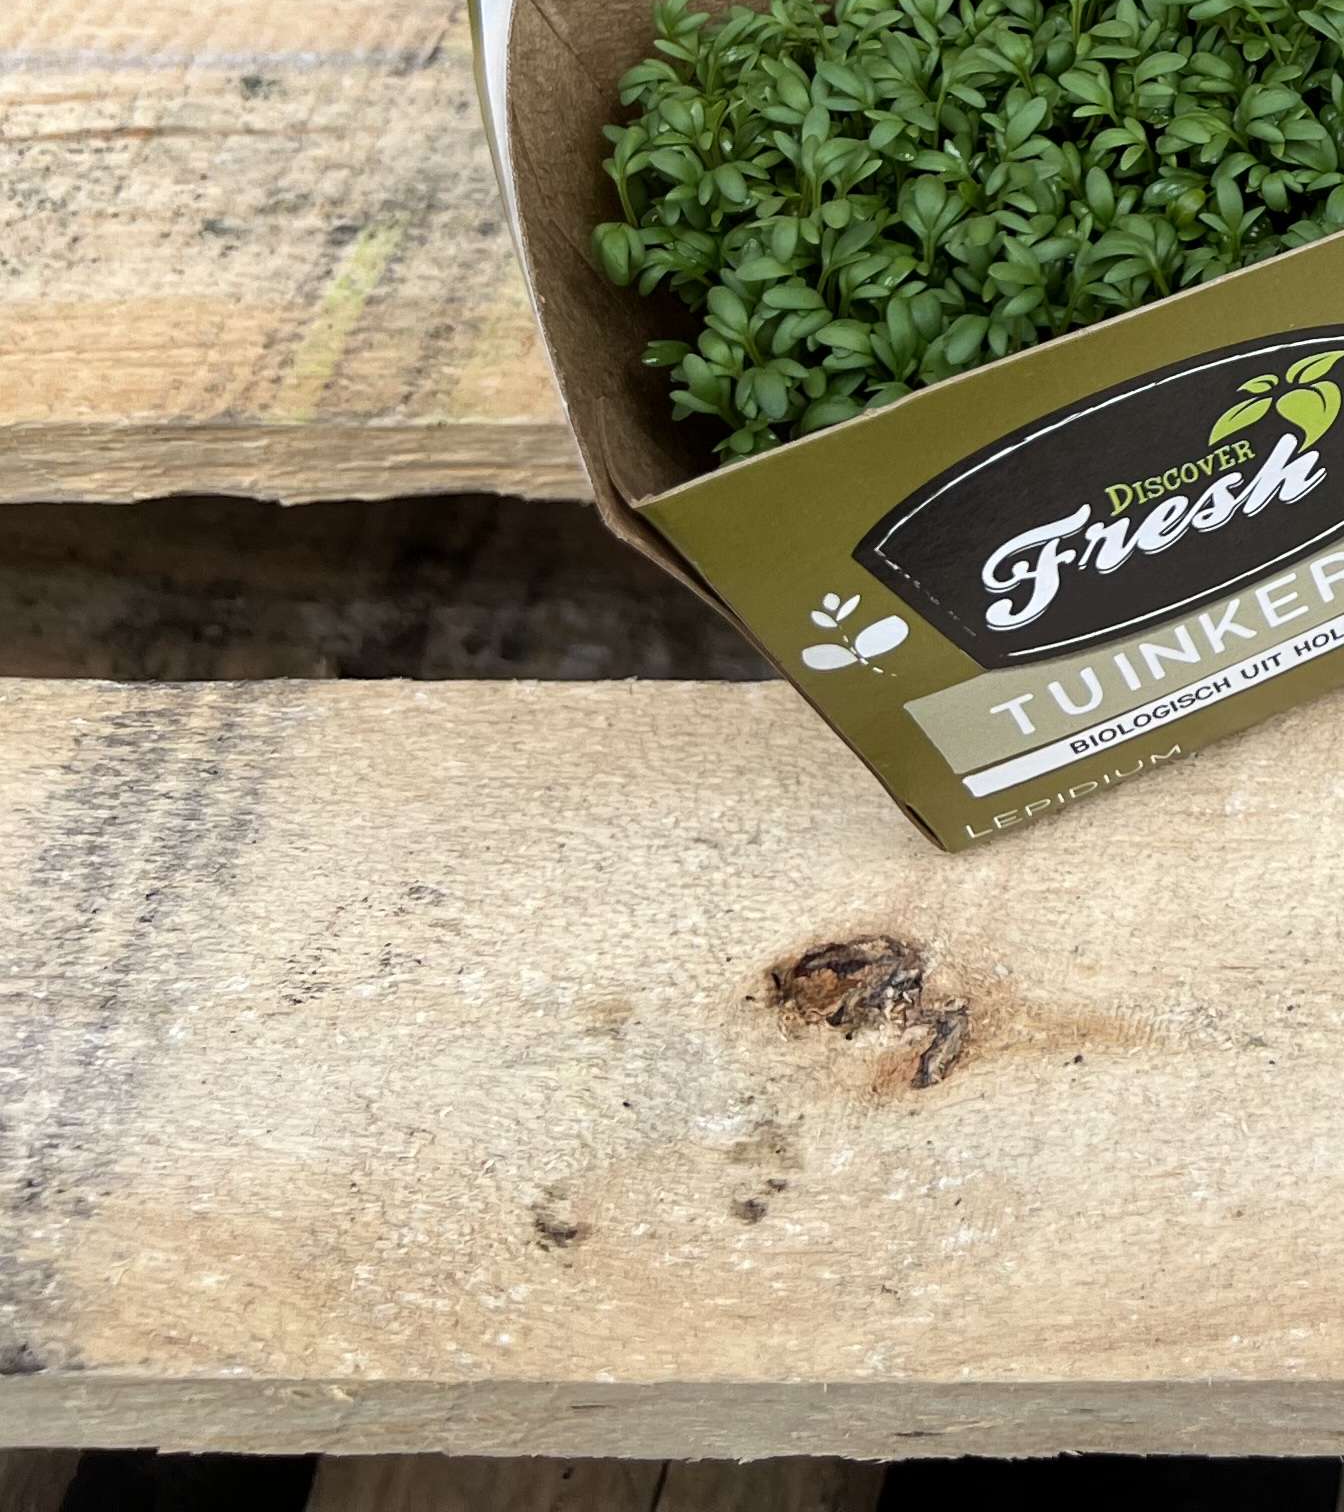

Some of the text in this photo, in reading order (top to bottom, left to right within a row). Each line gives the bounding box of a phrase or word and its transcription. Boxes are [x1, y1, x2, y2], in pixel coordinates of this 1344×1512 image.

[980, 432, 1328, 631] Fresh
[1068, 677, 1232, 755] BIOLOGISCH
[1240, 652, 1282, 680] UIT
[965, 744, 1182, 839] LEPIDIUM
